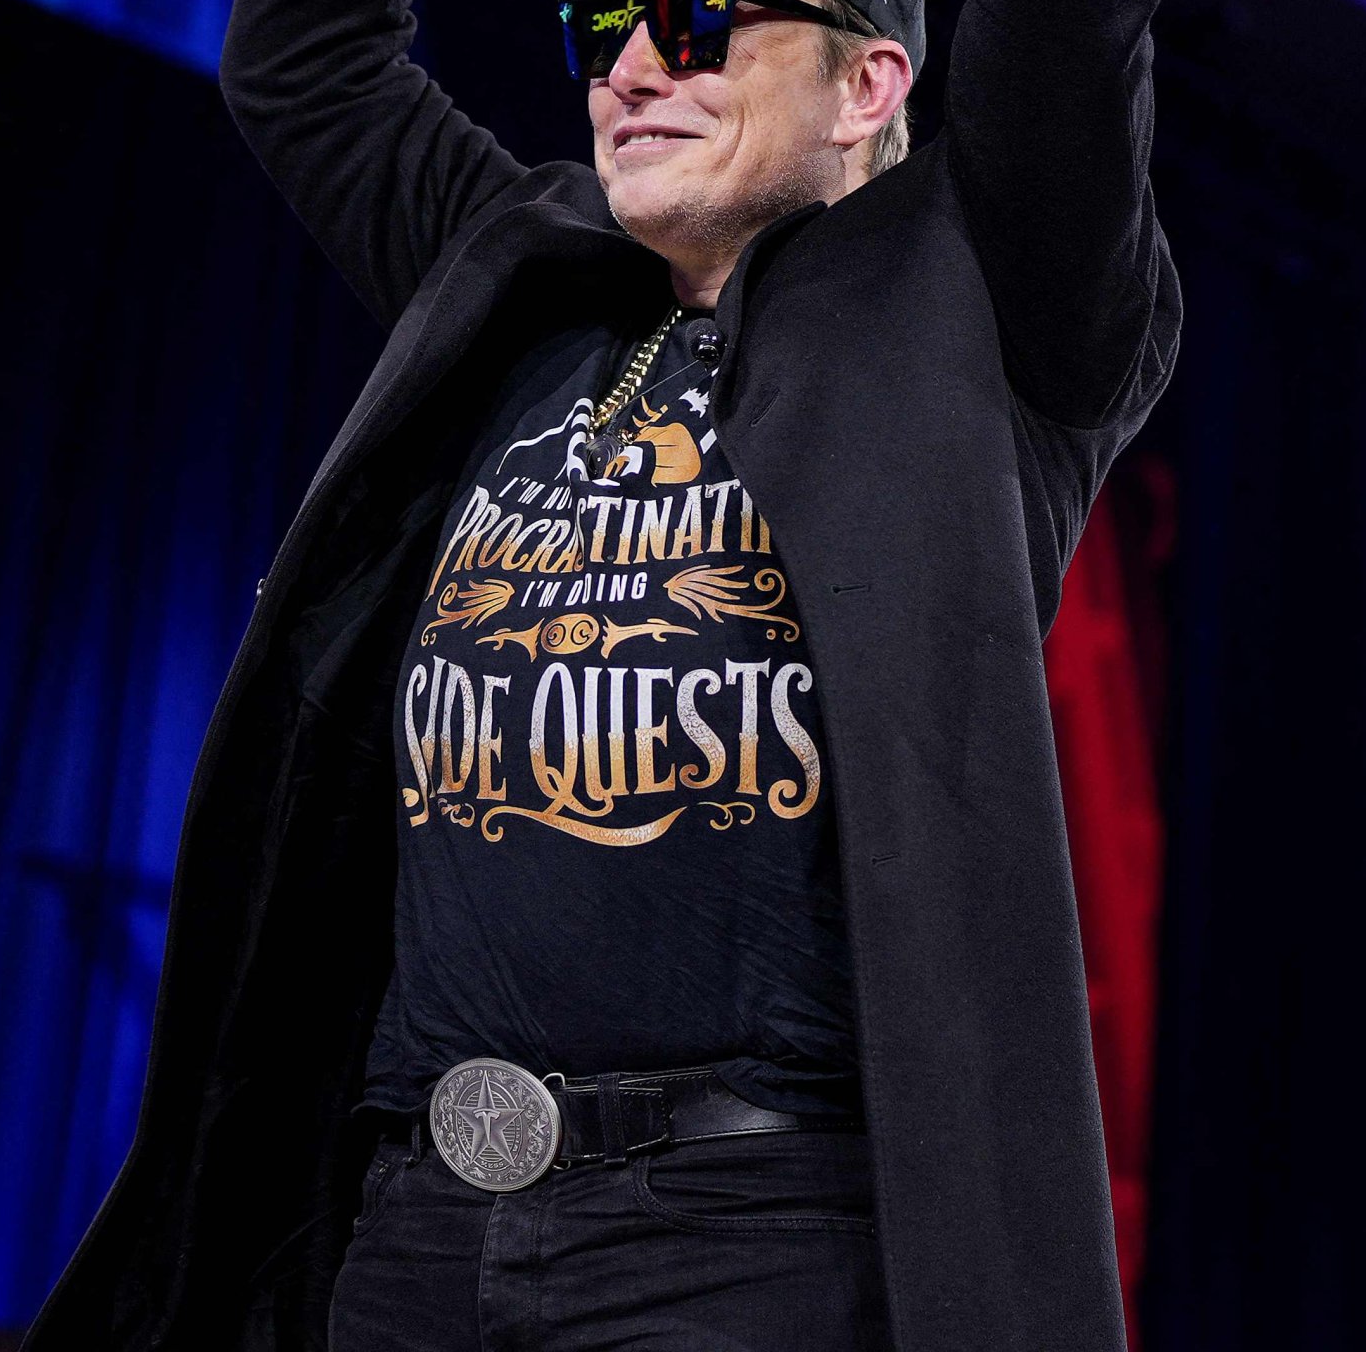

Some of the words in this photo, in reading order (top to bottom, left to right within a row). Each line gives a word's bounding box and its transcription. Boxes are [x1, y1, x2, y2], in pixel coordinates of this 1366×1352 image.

[521, 580, 561, 607] I'M
[565, 571, 647, 606] DOING
[402, 655, 512, 827] SIDE
[529, 658, 822, 820] QUESTS
